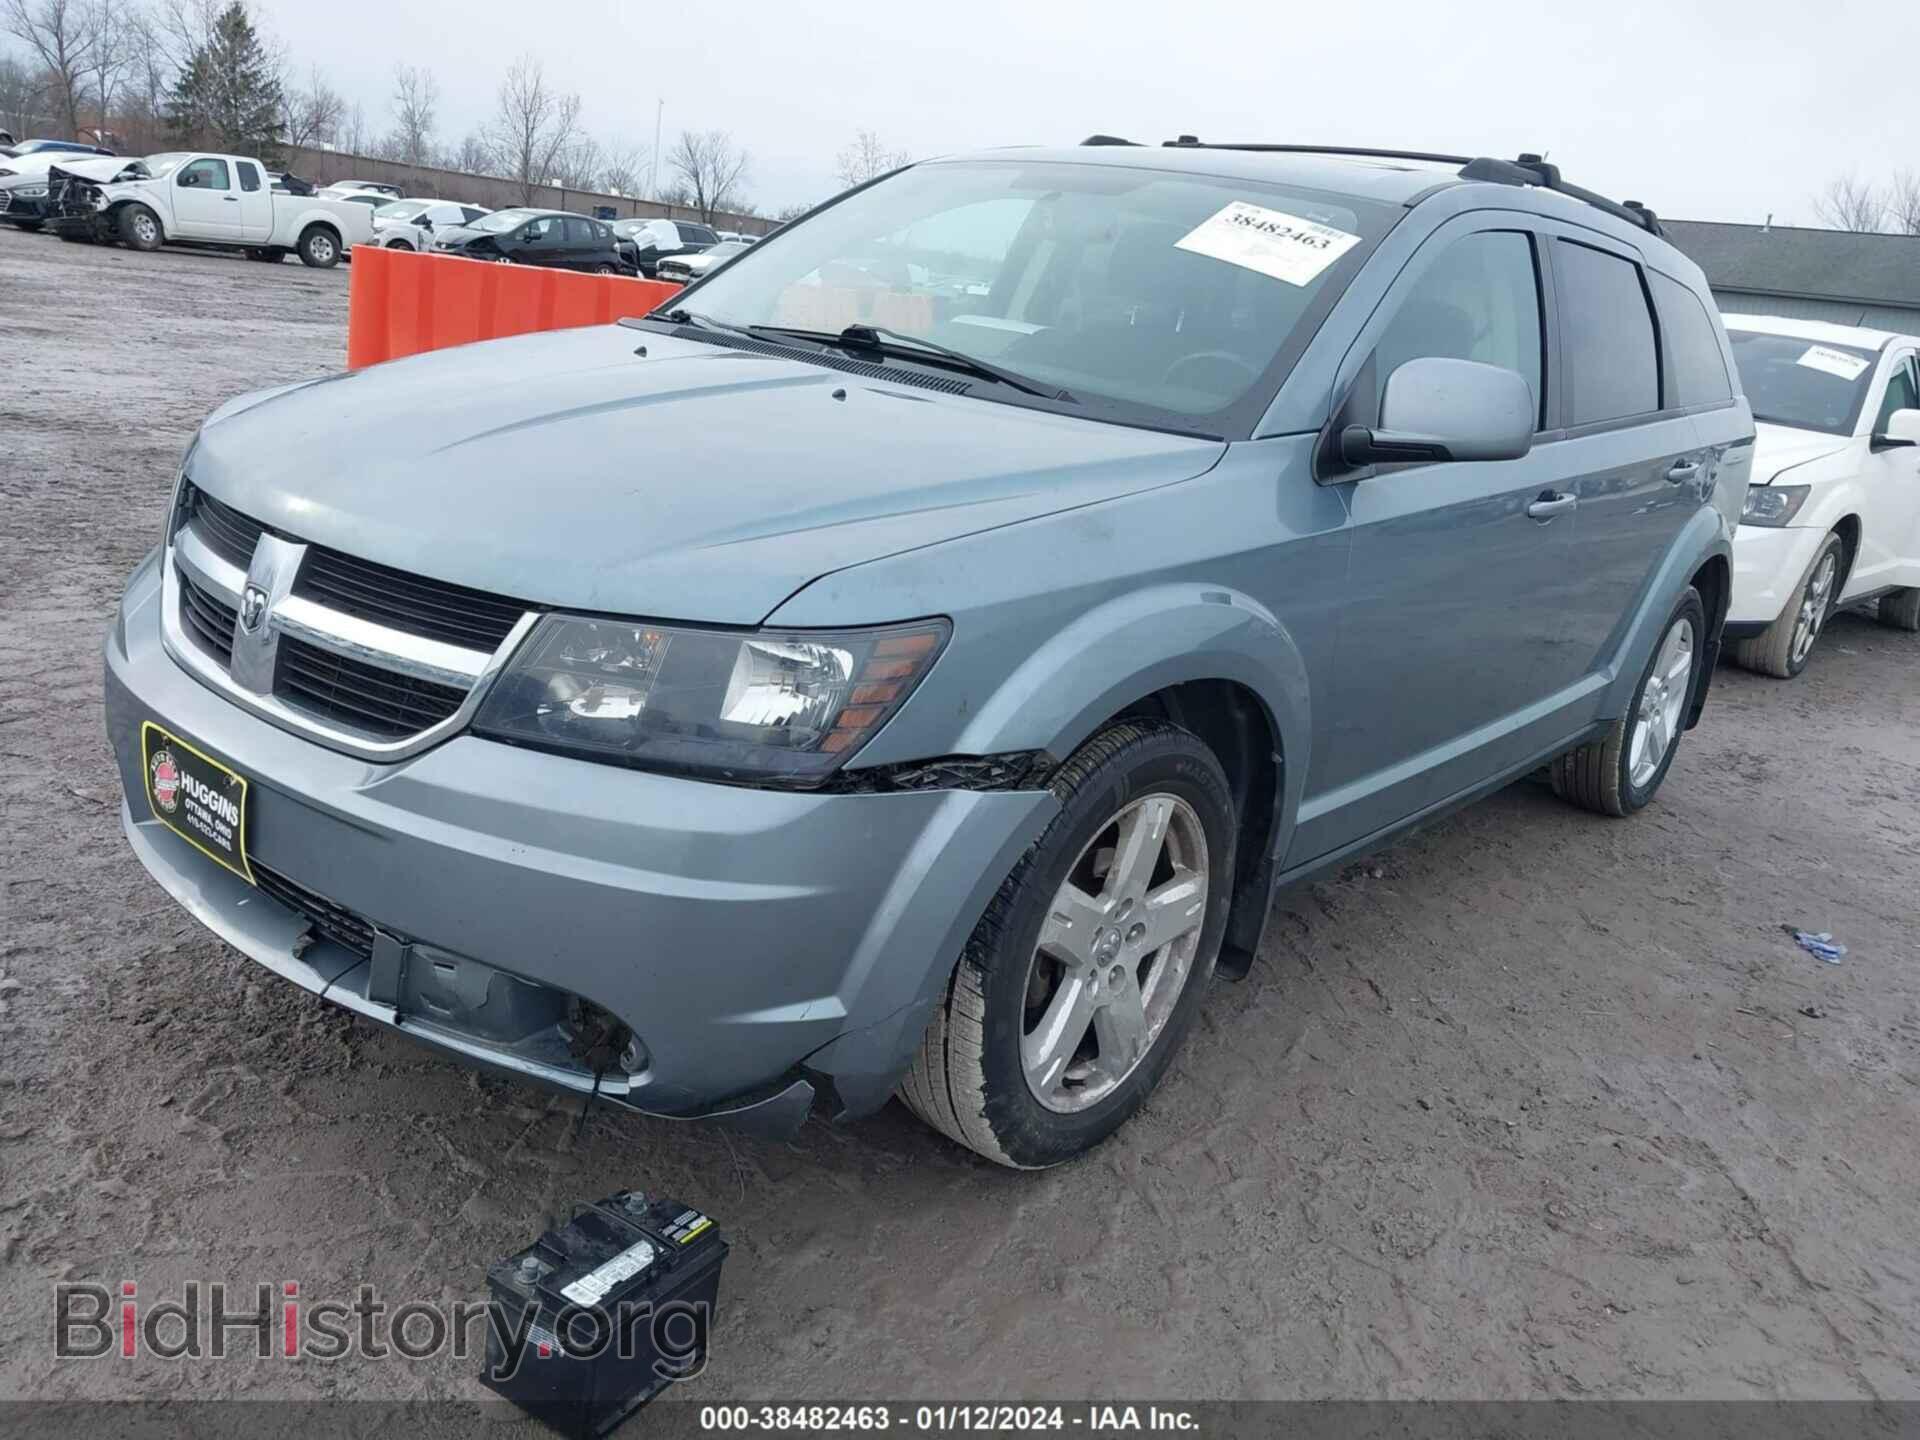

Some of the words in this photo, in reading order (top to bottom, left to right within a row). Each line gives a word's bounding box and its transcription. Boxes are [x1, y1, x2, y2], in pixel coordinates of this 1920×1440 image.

[1225, 213, 1331, 249] 38482463
[180, 770, 239, 827] HUGGINS
[214, 820, 232, 840] OHIO
